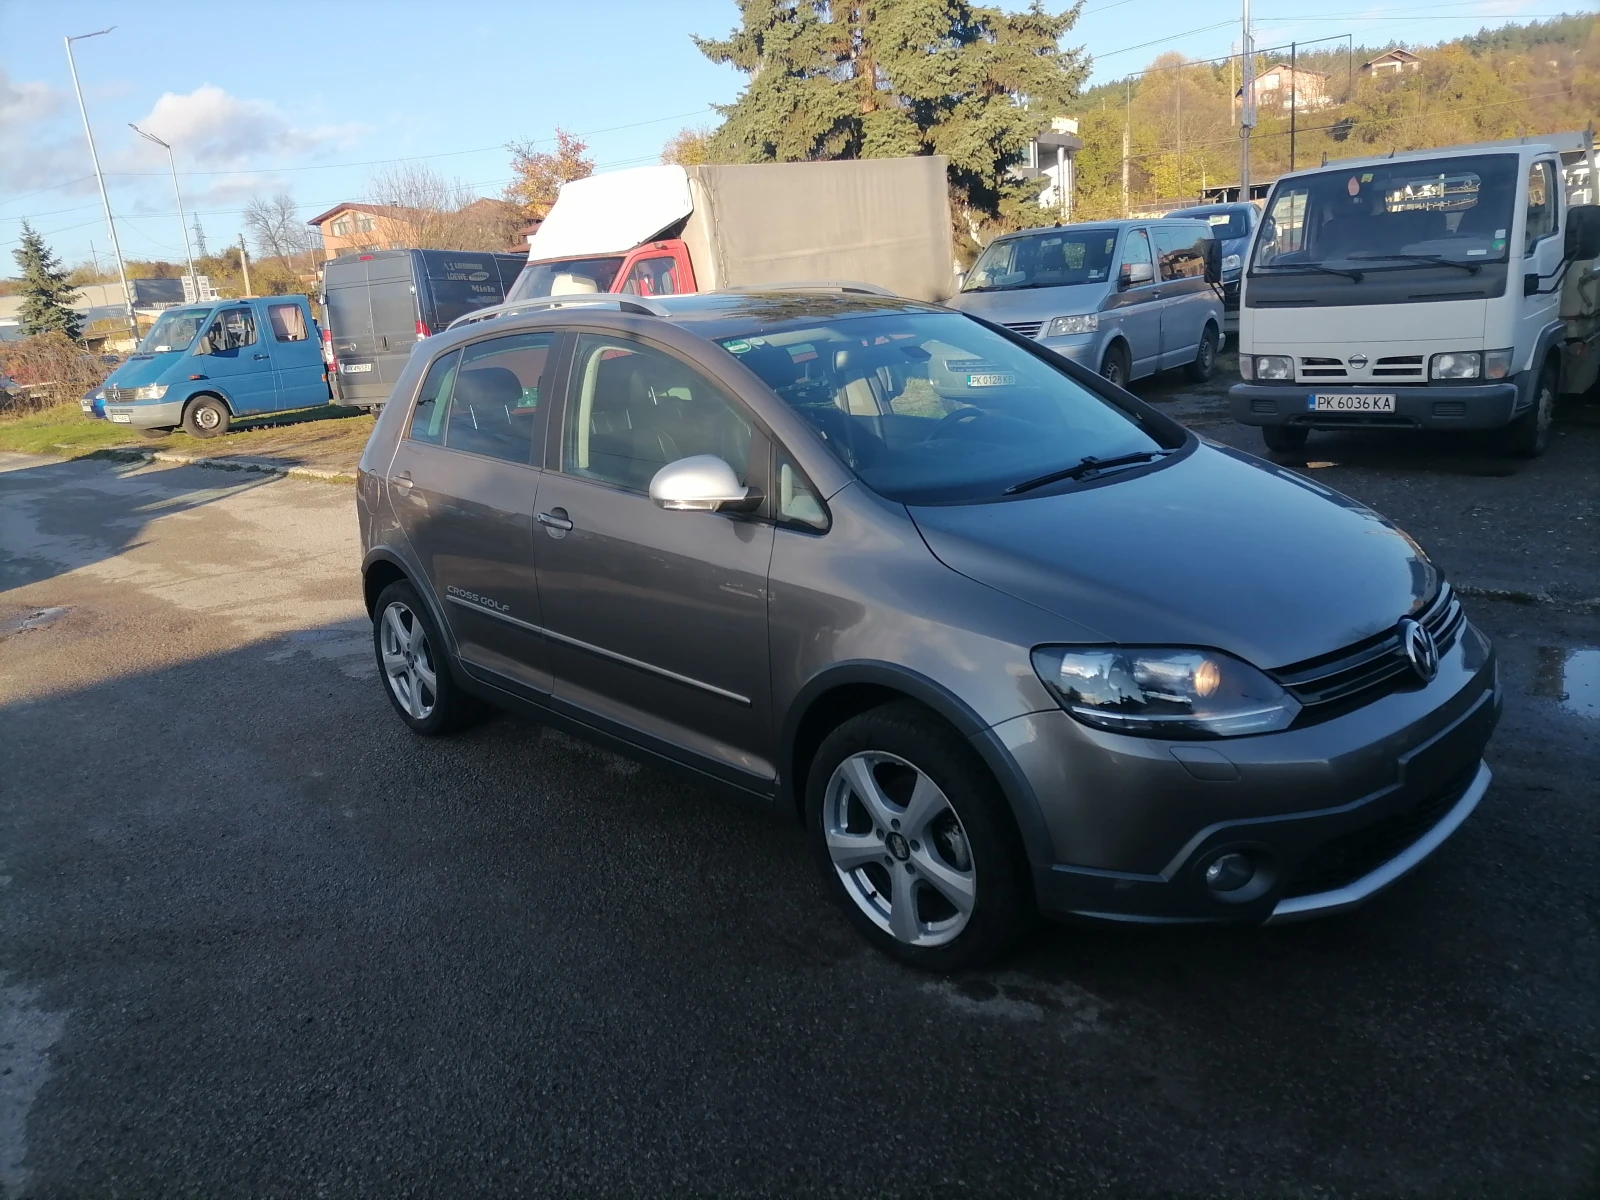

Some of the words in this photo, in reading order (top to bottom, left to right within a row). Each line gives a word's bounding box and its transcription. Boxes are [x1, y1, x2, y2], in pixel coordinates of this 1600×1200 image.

[446, 272, 468, 281] LOEWE
[471, 284, 495, 292] Miele
[1317, 396, 1335, 409] PK
[1337, 396, 1370, 409] 6036
[1373, 396, 1391, 410] KA
[447, 585, 479, 601] CROSS
[480, 596, 510, 611] GOLF
